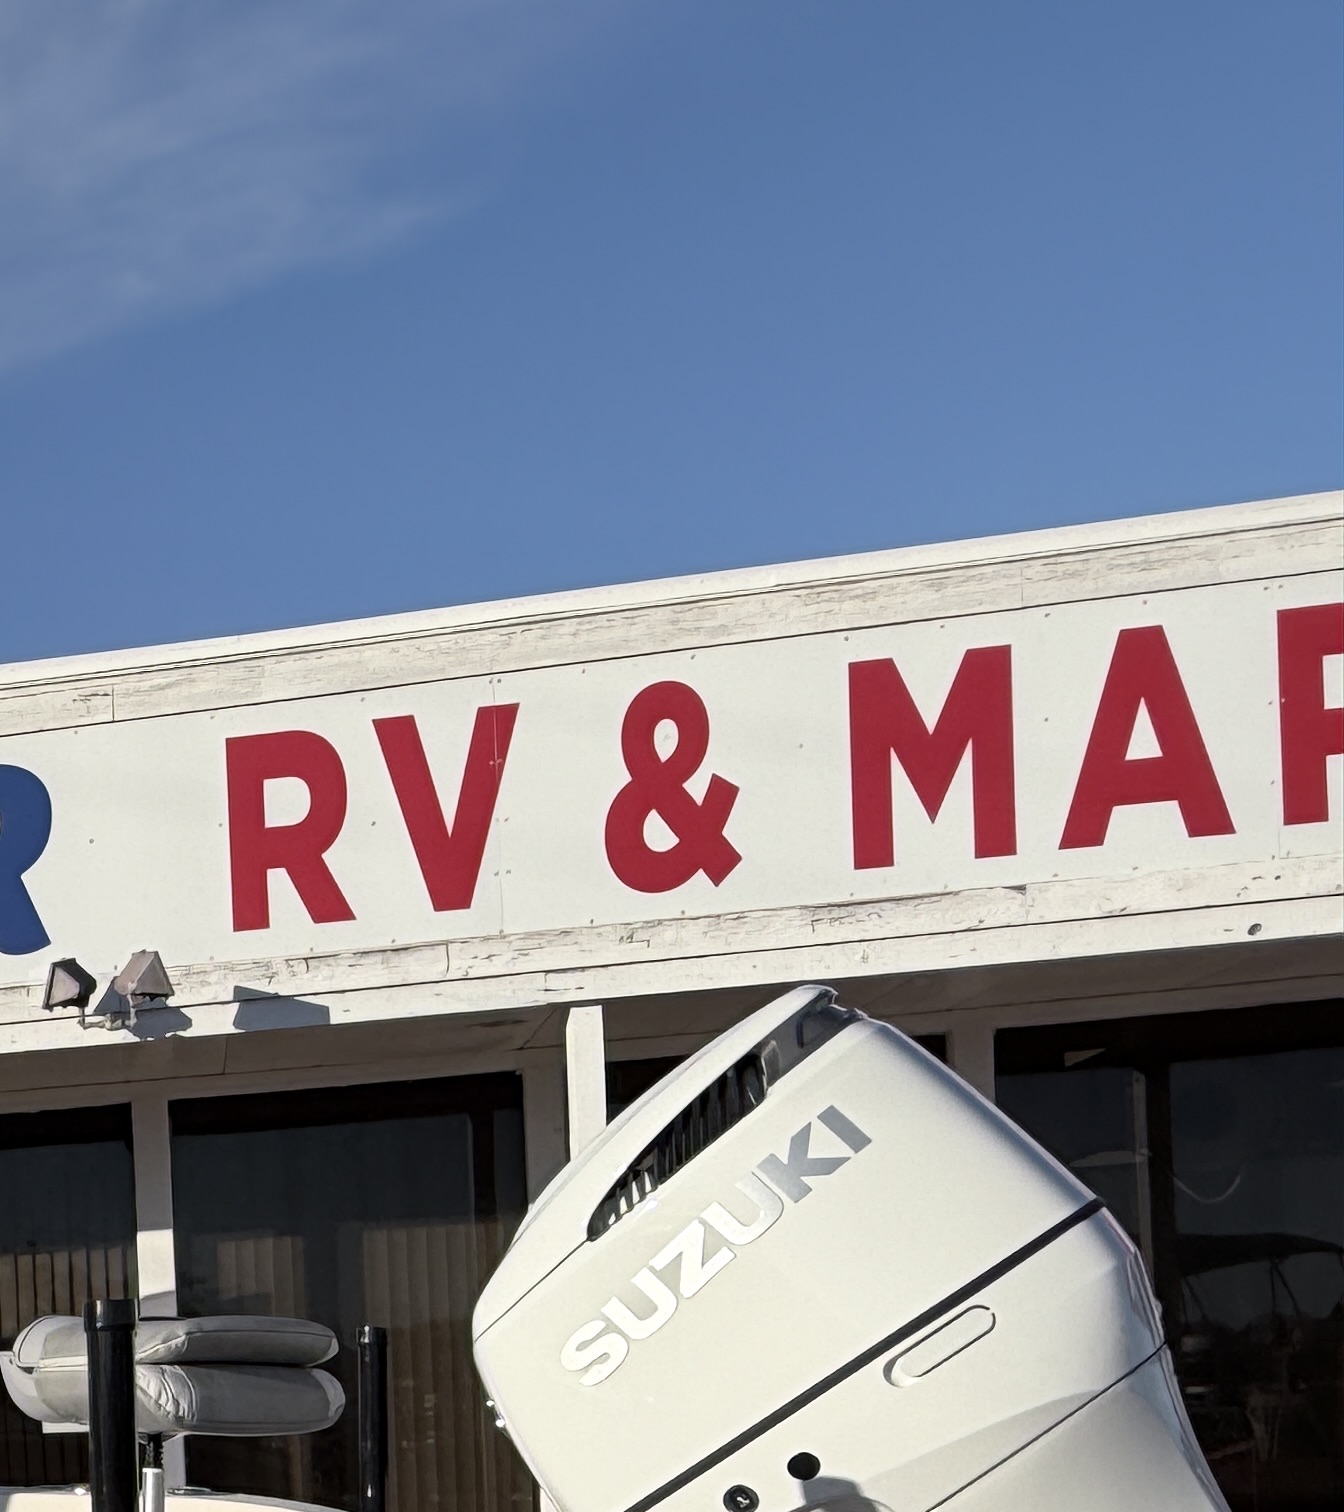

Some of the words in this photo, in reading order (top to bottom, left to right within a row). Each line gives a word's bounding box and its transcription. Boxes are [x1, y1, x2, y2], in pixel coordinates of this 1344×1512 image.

[225, 702, 520, 932] RV
[604, 680, 743, 894] &
[560, 1104, 872, 1387] SUZUKI
